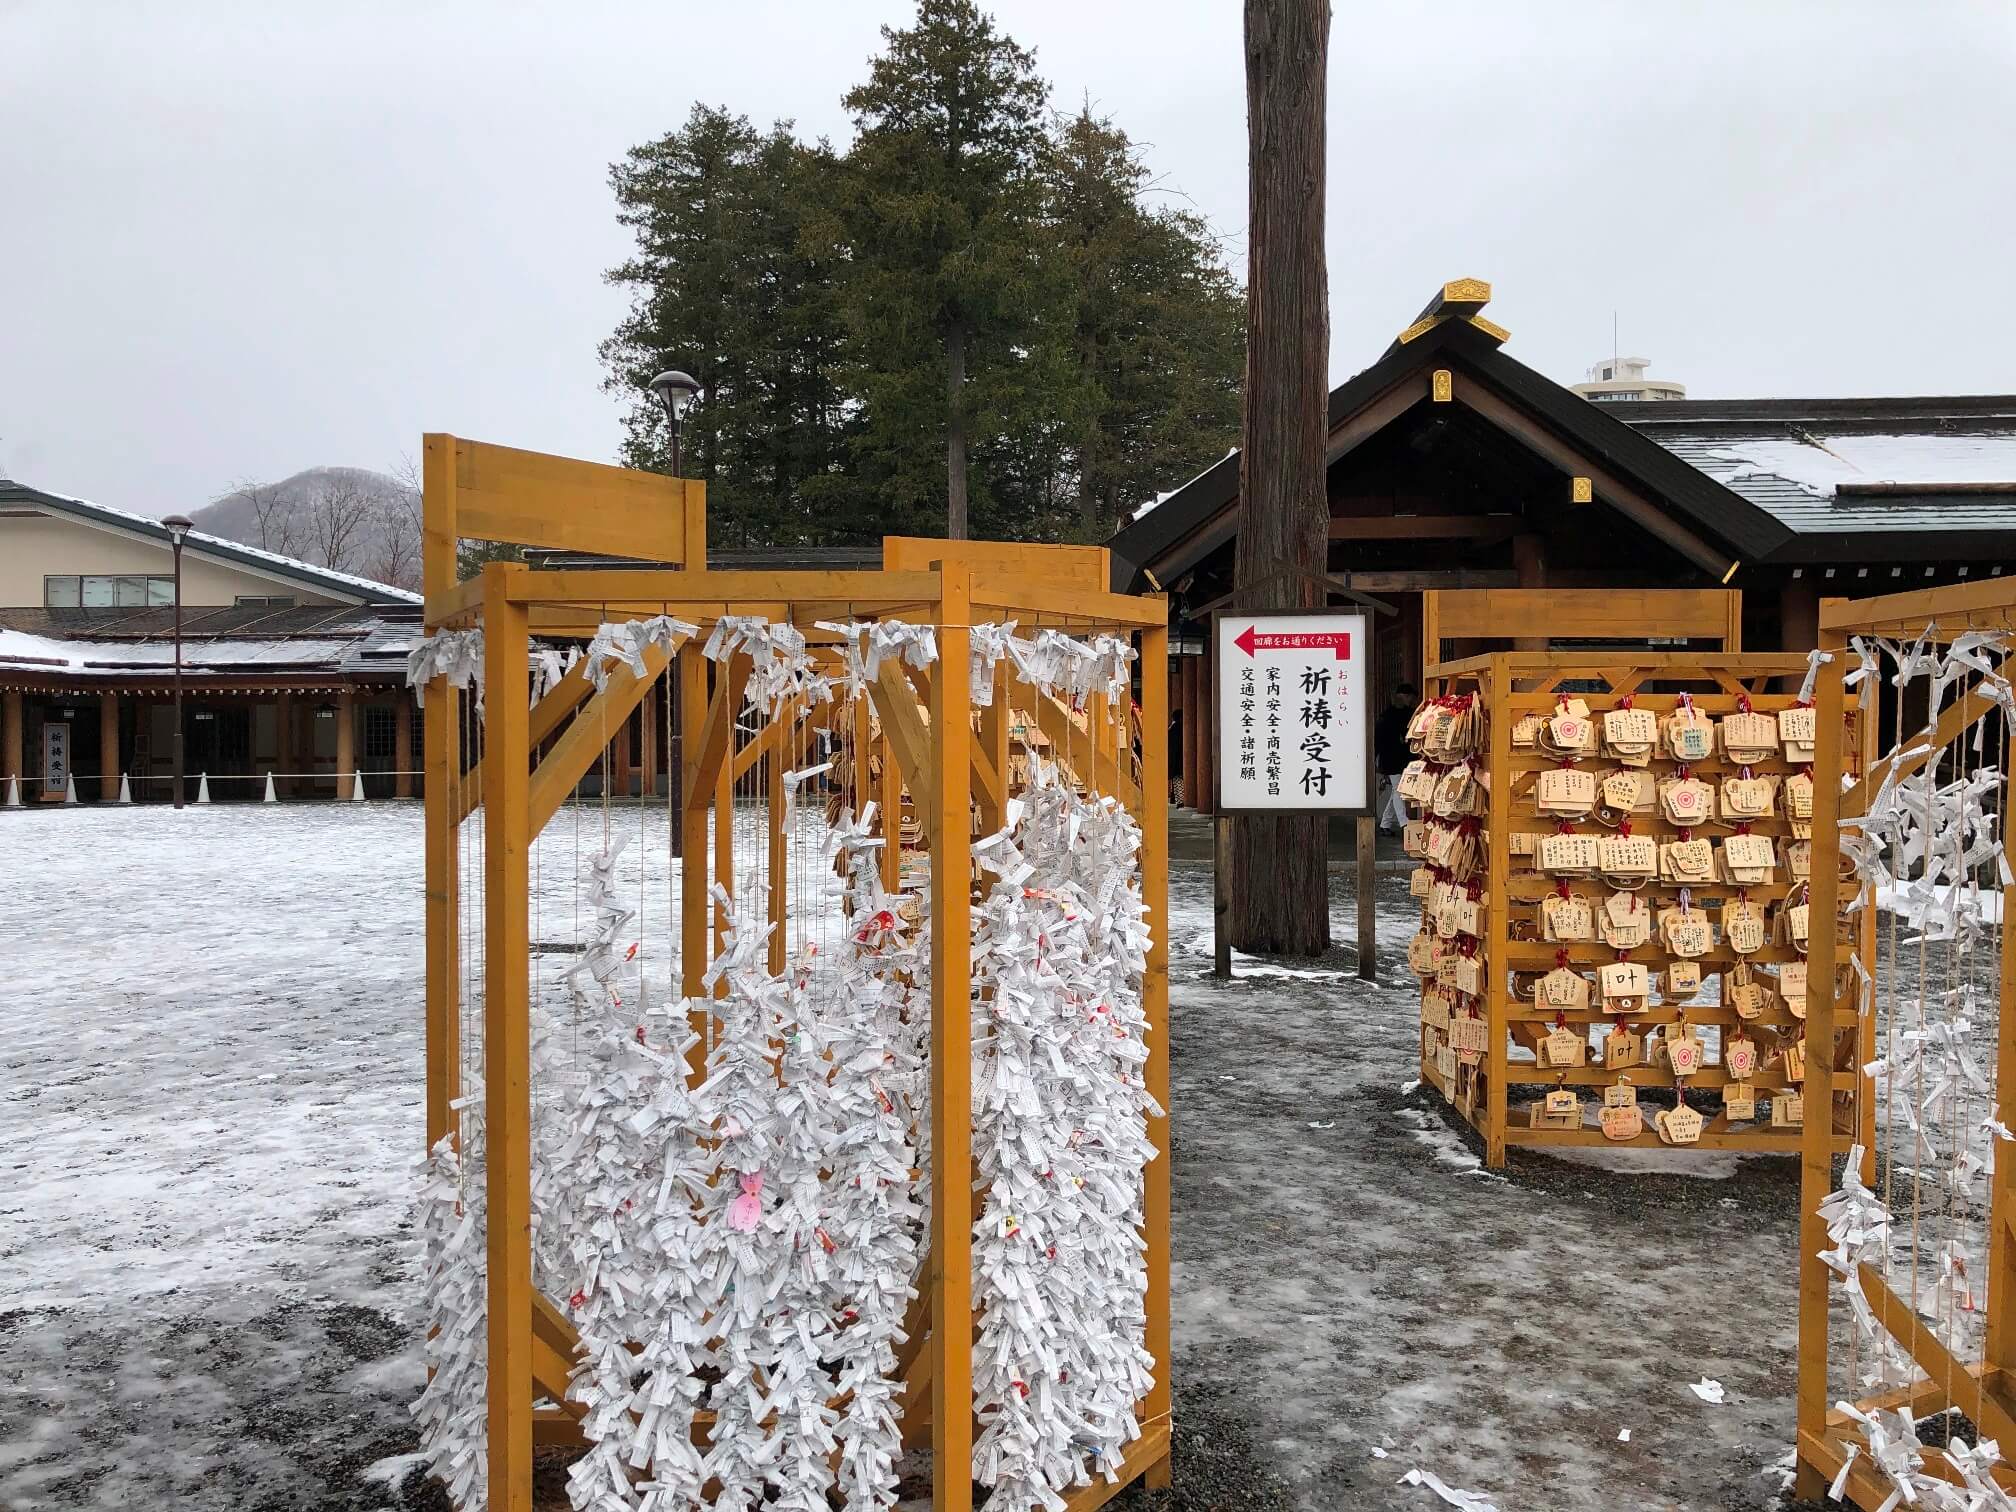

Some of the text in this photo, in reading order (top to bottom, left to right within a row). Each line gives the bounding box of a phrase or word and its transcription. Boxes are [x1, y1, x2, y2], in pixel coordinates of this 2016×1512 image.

[1254, 636, 1343, 645] 回廊をお通りください
[1239, 666, 1256, 781] 交通安全・諸祈願
[1338, 670, 1349, 727] おはらい
[1265, 666, 1281, 796] 家内安全・商売繁昌
[1299, 665, 1333, 797] 祈祷受付
[1615, 968, 1638, 990] 叶
[1617, 1040, 1633, 1059] 叶
